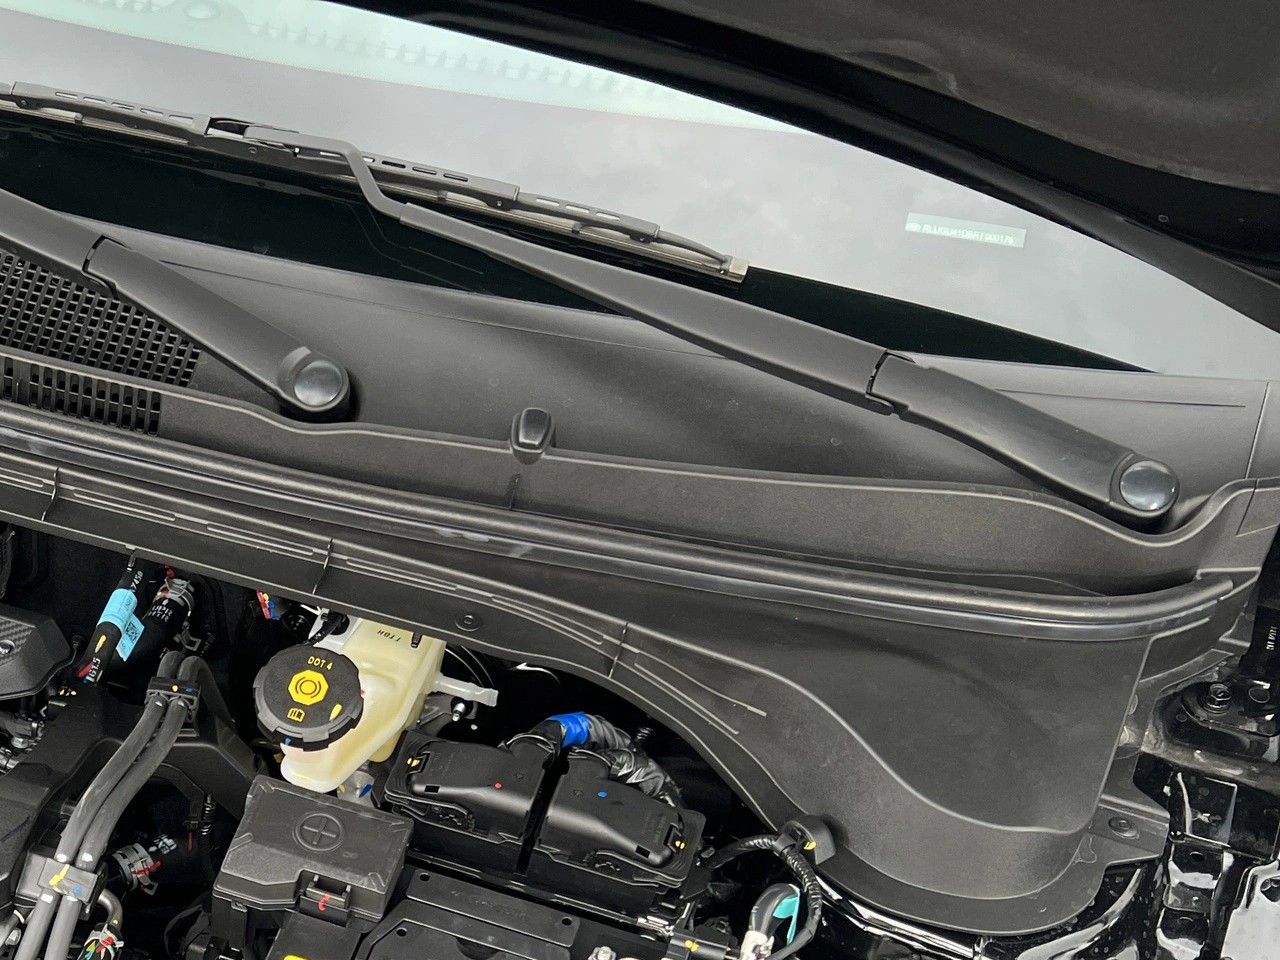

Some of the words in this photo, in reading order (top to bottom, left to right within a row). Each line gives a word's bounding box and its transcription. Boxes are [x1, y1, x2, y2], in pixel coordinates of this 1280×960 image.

[152, 605, 173, 617] UPR
[307, 655, 326, 668] DOT
[326, 662, 333, 670] 4
